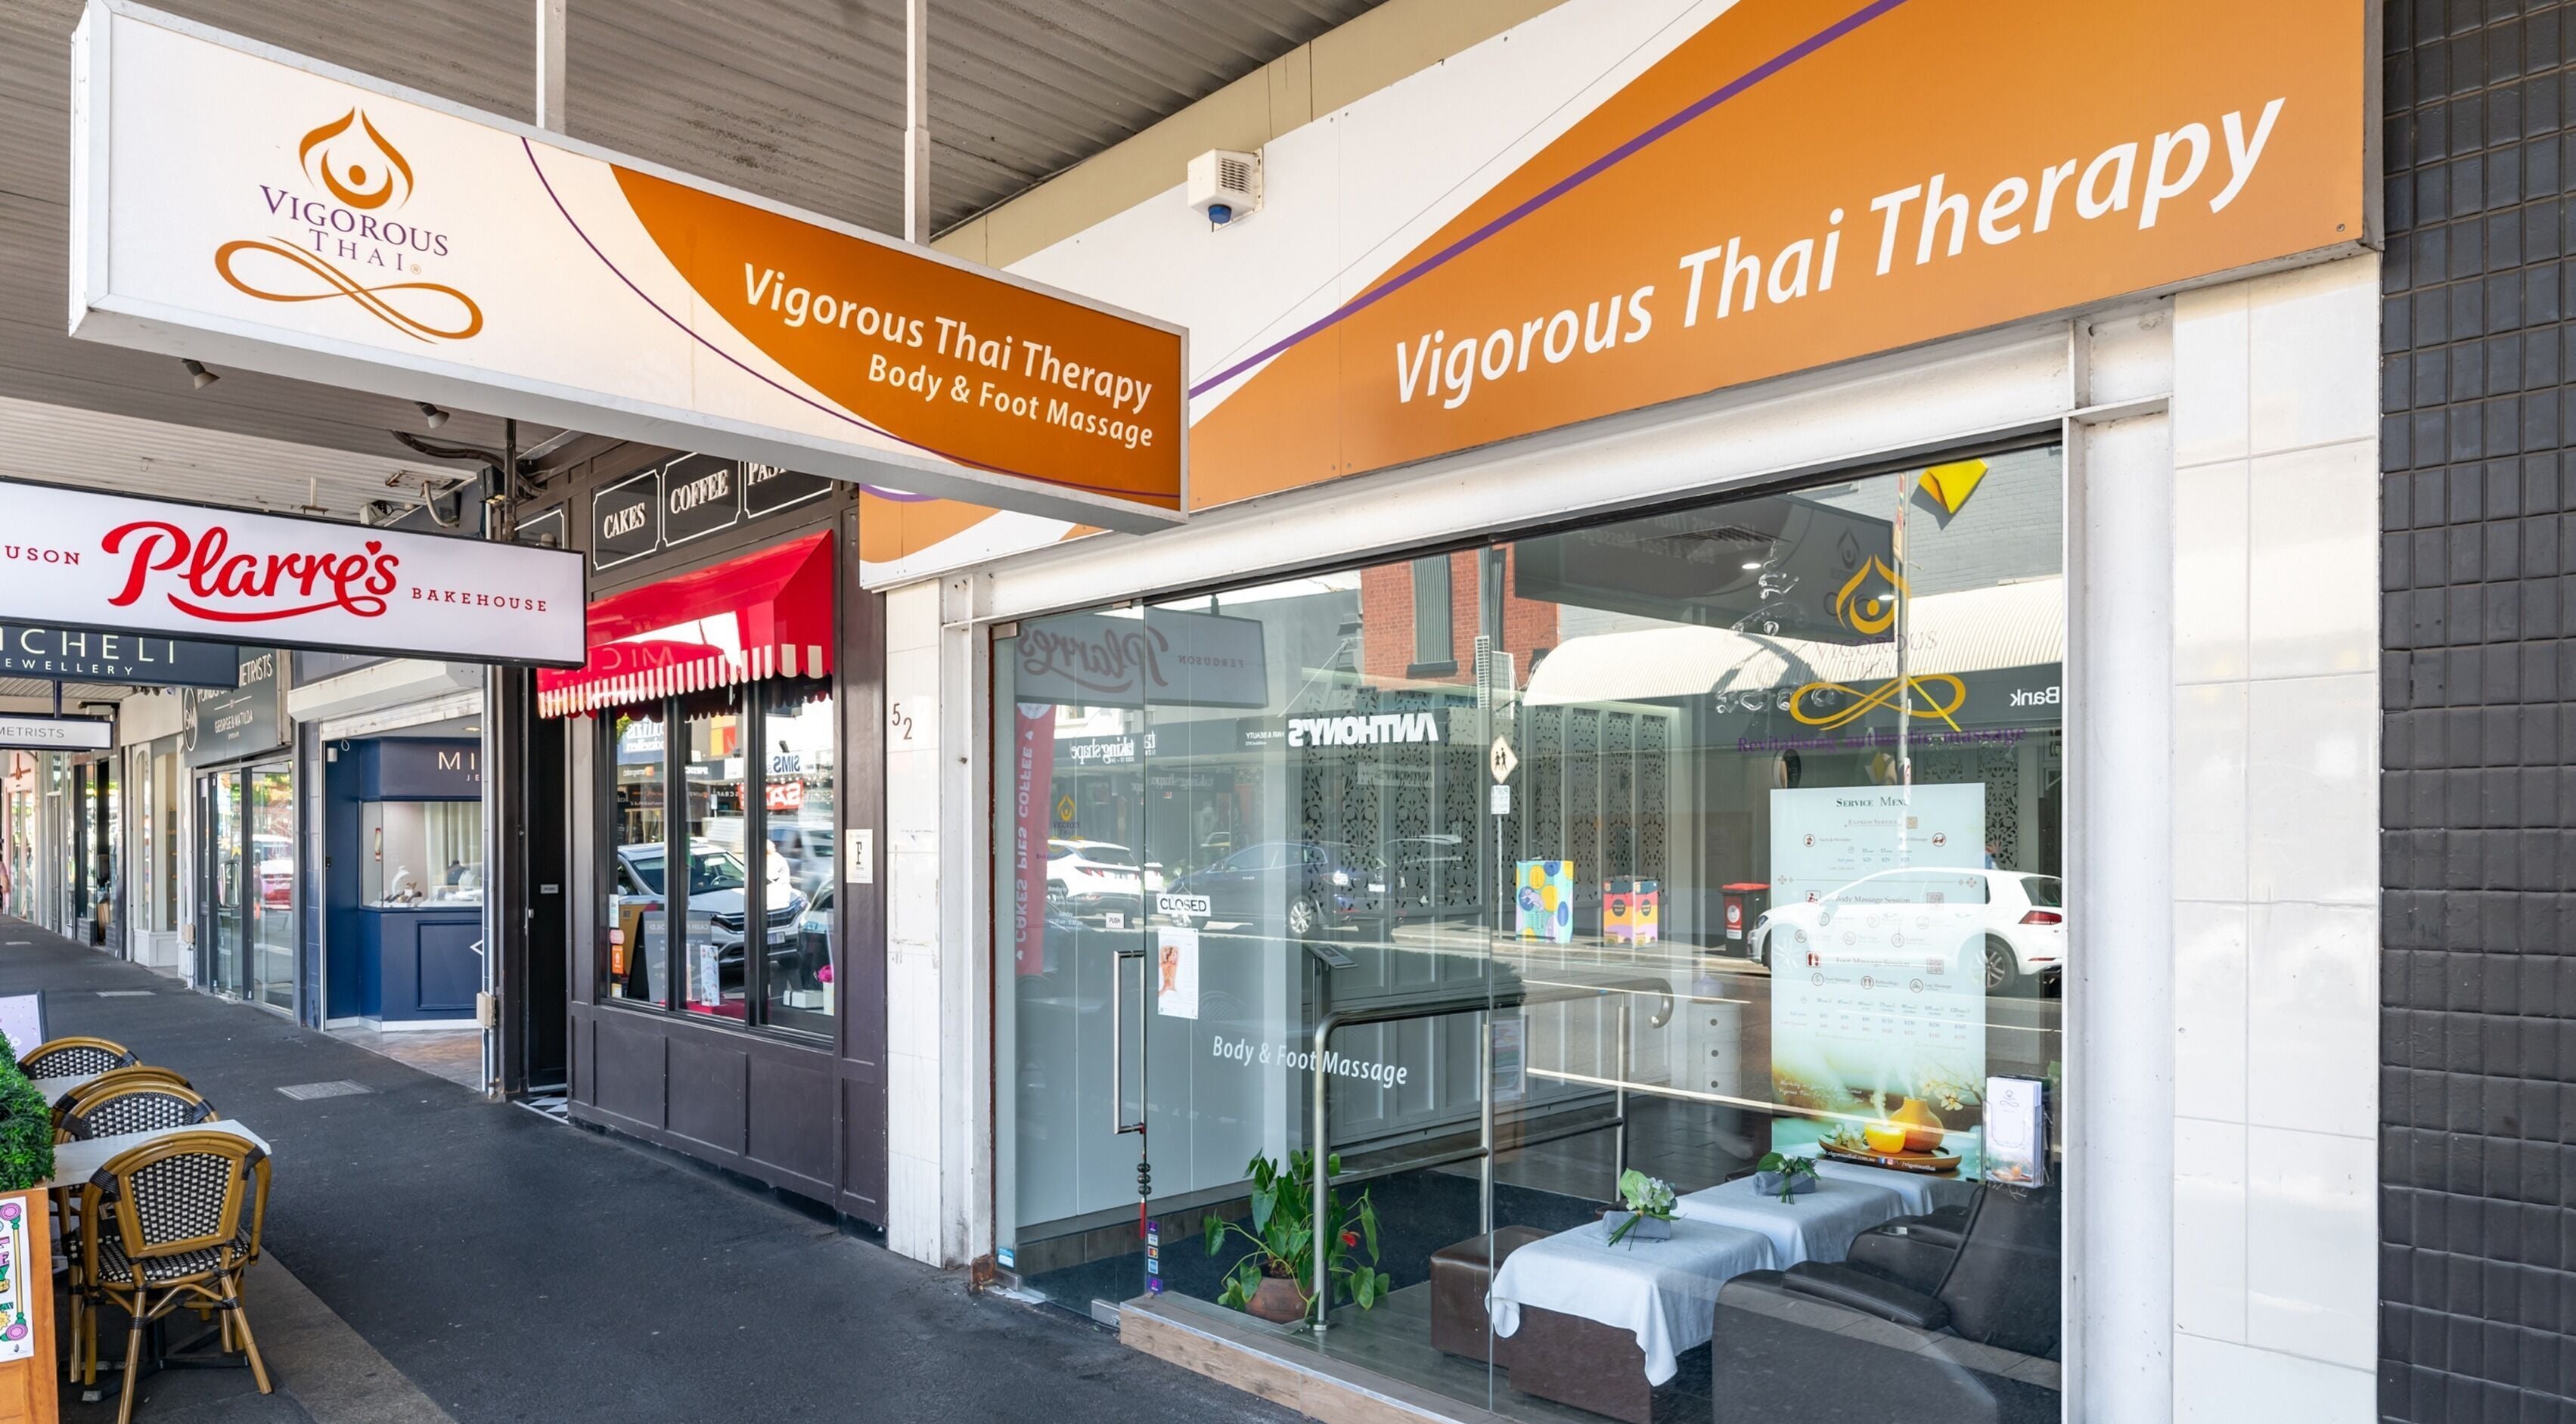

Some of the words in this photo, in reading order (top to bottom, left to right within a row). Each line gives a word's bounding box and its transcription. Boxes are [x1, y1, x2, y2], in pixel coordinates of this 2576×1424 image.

[259, 184, 448, 258] VIGOROUS
[309, 227, 405, 273] THAI
[1395, 282, 1656, 411] Vigorous
[1677, 206, 1845, 328] Thai
[1868, 95, 2287, 277] Therapy
[743, 262, 924, 349] Vigorous
[934, 315, 1013, 372] Thai
[1022, 340, 1153, 415] Therapy
[868, 353, 943, 403] Body
[950, 375, 970, 405] &
[979, 380, 1040, 422] Foot
[1047, 401, 1153, 450] Massage
[670, 469, 729, 514] COFFEE
[604, 503, 647, 539] CAKES
[411, 587, 548, 613] BAKEHOUSE
[1944, 724, 2028, 749] massage
[1836, 798, 1873, 808] SERVICE
[1159, 898, 1207, 912] CLOSED
[1212, 1035, 1254, 1067] Body
[1259, 1042, 1271, 1065] &
[1277, 1044, 1316, 1072] Foot
[1322, 1050, 1408, 1088] Massage
